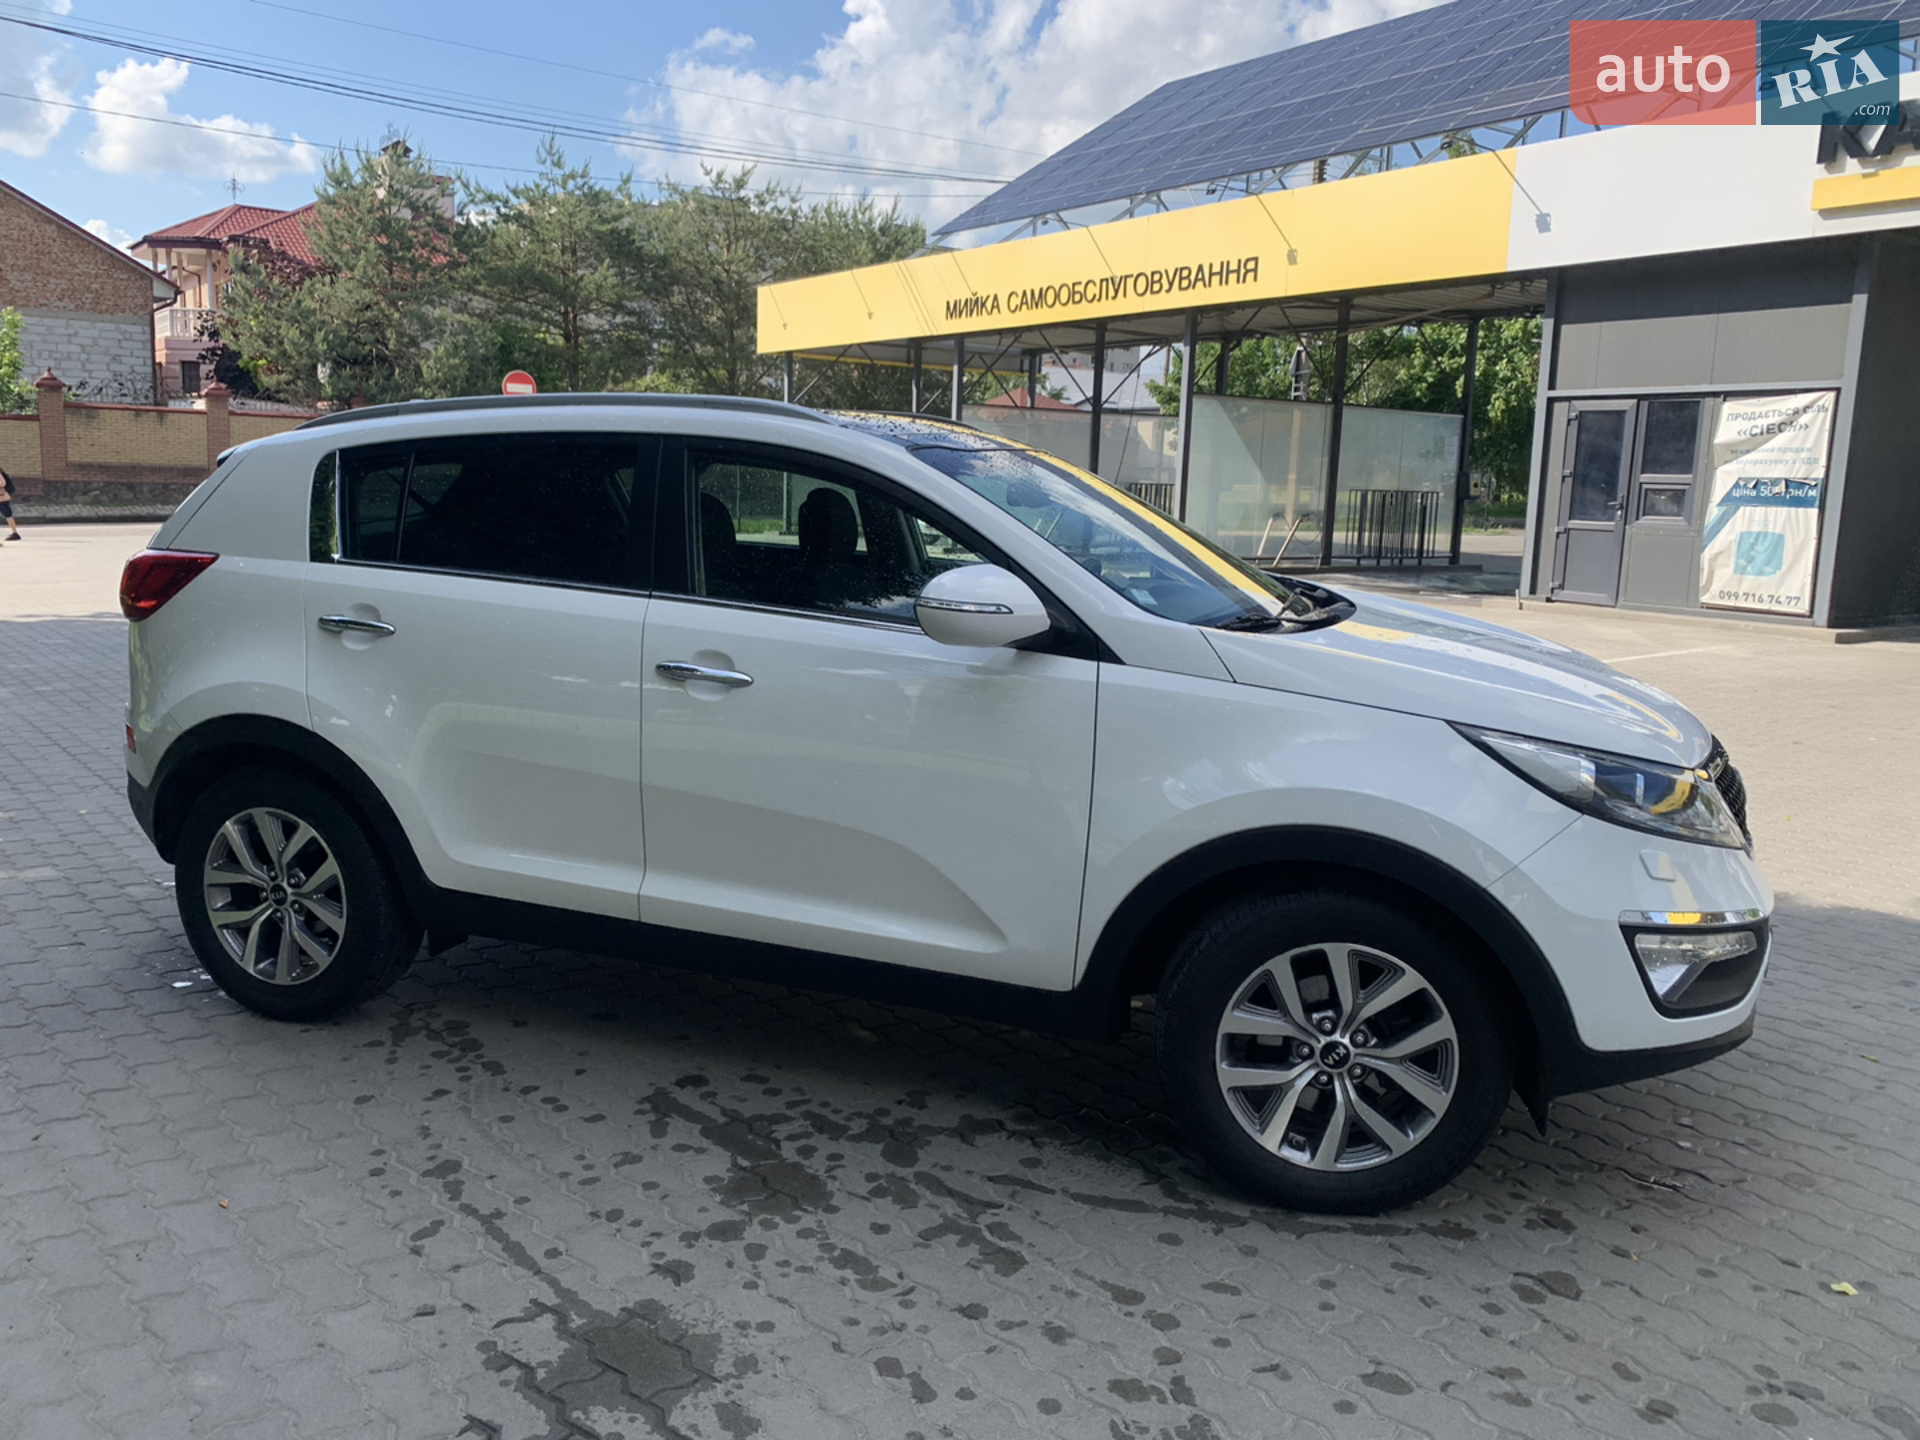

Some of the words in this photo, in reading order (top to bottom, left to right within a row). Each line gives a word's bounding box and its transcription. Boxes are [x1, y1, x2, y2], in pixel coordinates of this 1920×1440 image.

[945, 291, 1001, 321] МИЙКА
[1007, 256, 1260, 314] САМООБСЛУГОВУВАННЯ
[1726, 407, 1800, 422] ПРОДАЄТЬСЯ
[1718, 589, 1740, 601] 099
[1742, 592, 1765, 604] 716
[1767, 594, 1783, 605] 74
[1785, 595, 1801, 606] 77
[1324, 1046, 1347, 1066] KIA
